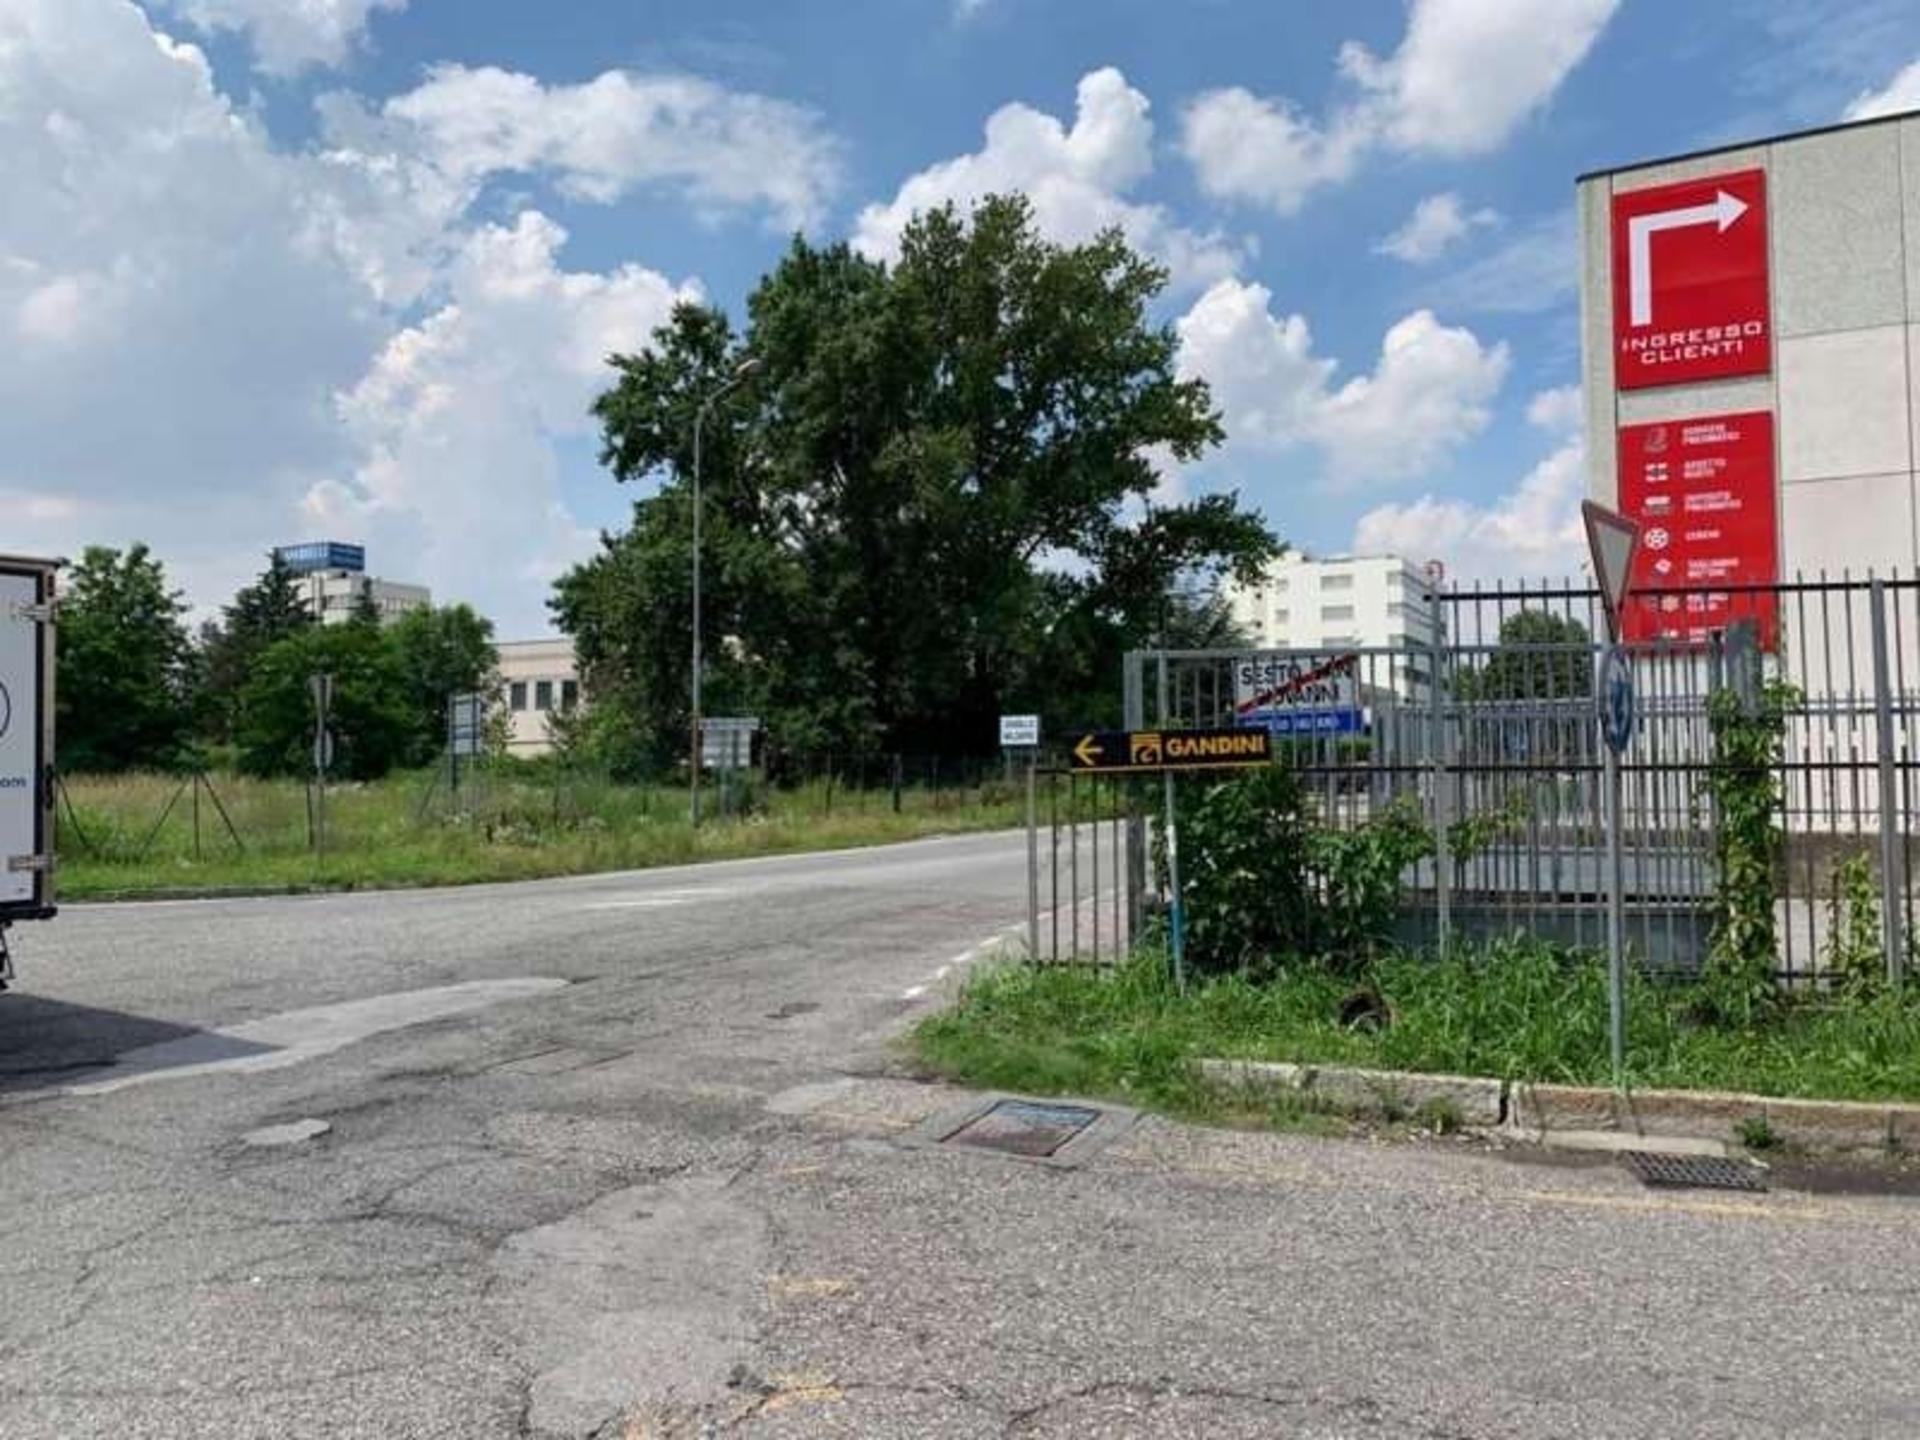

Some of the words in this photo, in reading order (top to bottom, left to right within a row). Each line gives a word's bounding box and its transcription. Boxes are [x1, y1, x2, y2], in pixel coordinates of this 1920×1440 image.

[1622, 321, 1762, 351] INGRESSO
[1641, 340, 1743, 364] CLIENTI
[1241, 663, 1301, 685] SESTO
[1166, 735, 1265, 757] GANDINI
